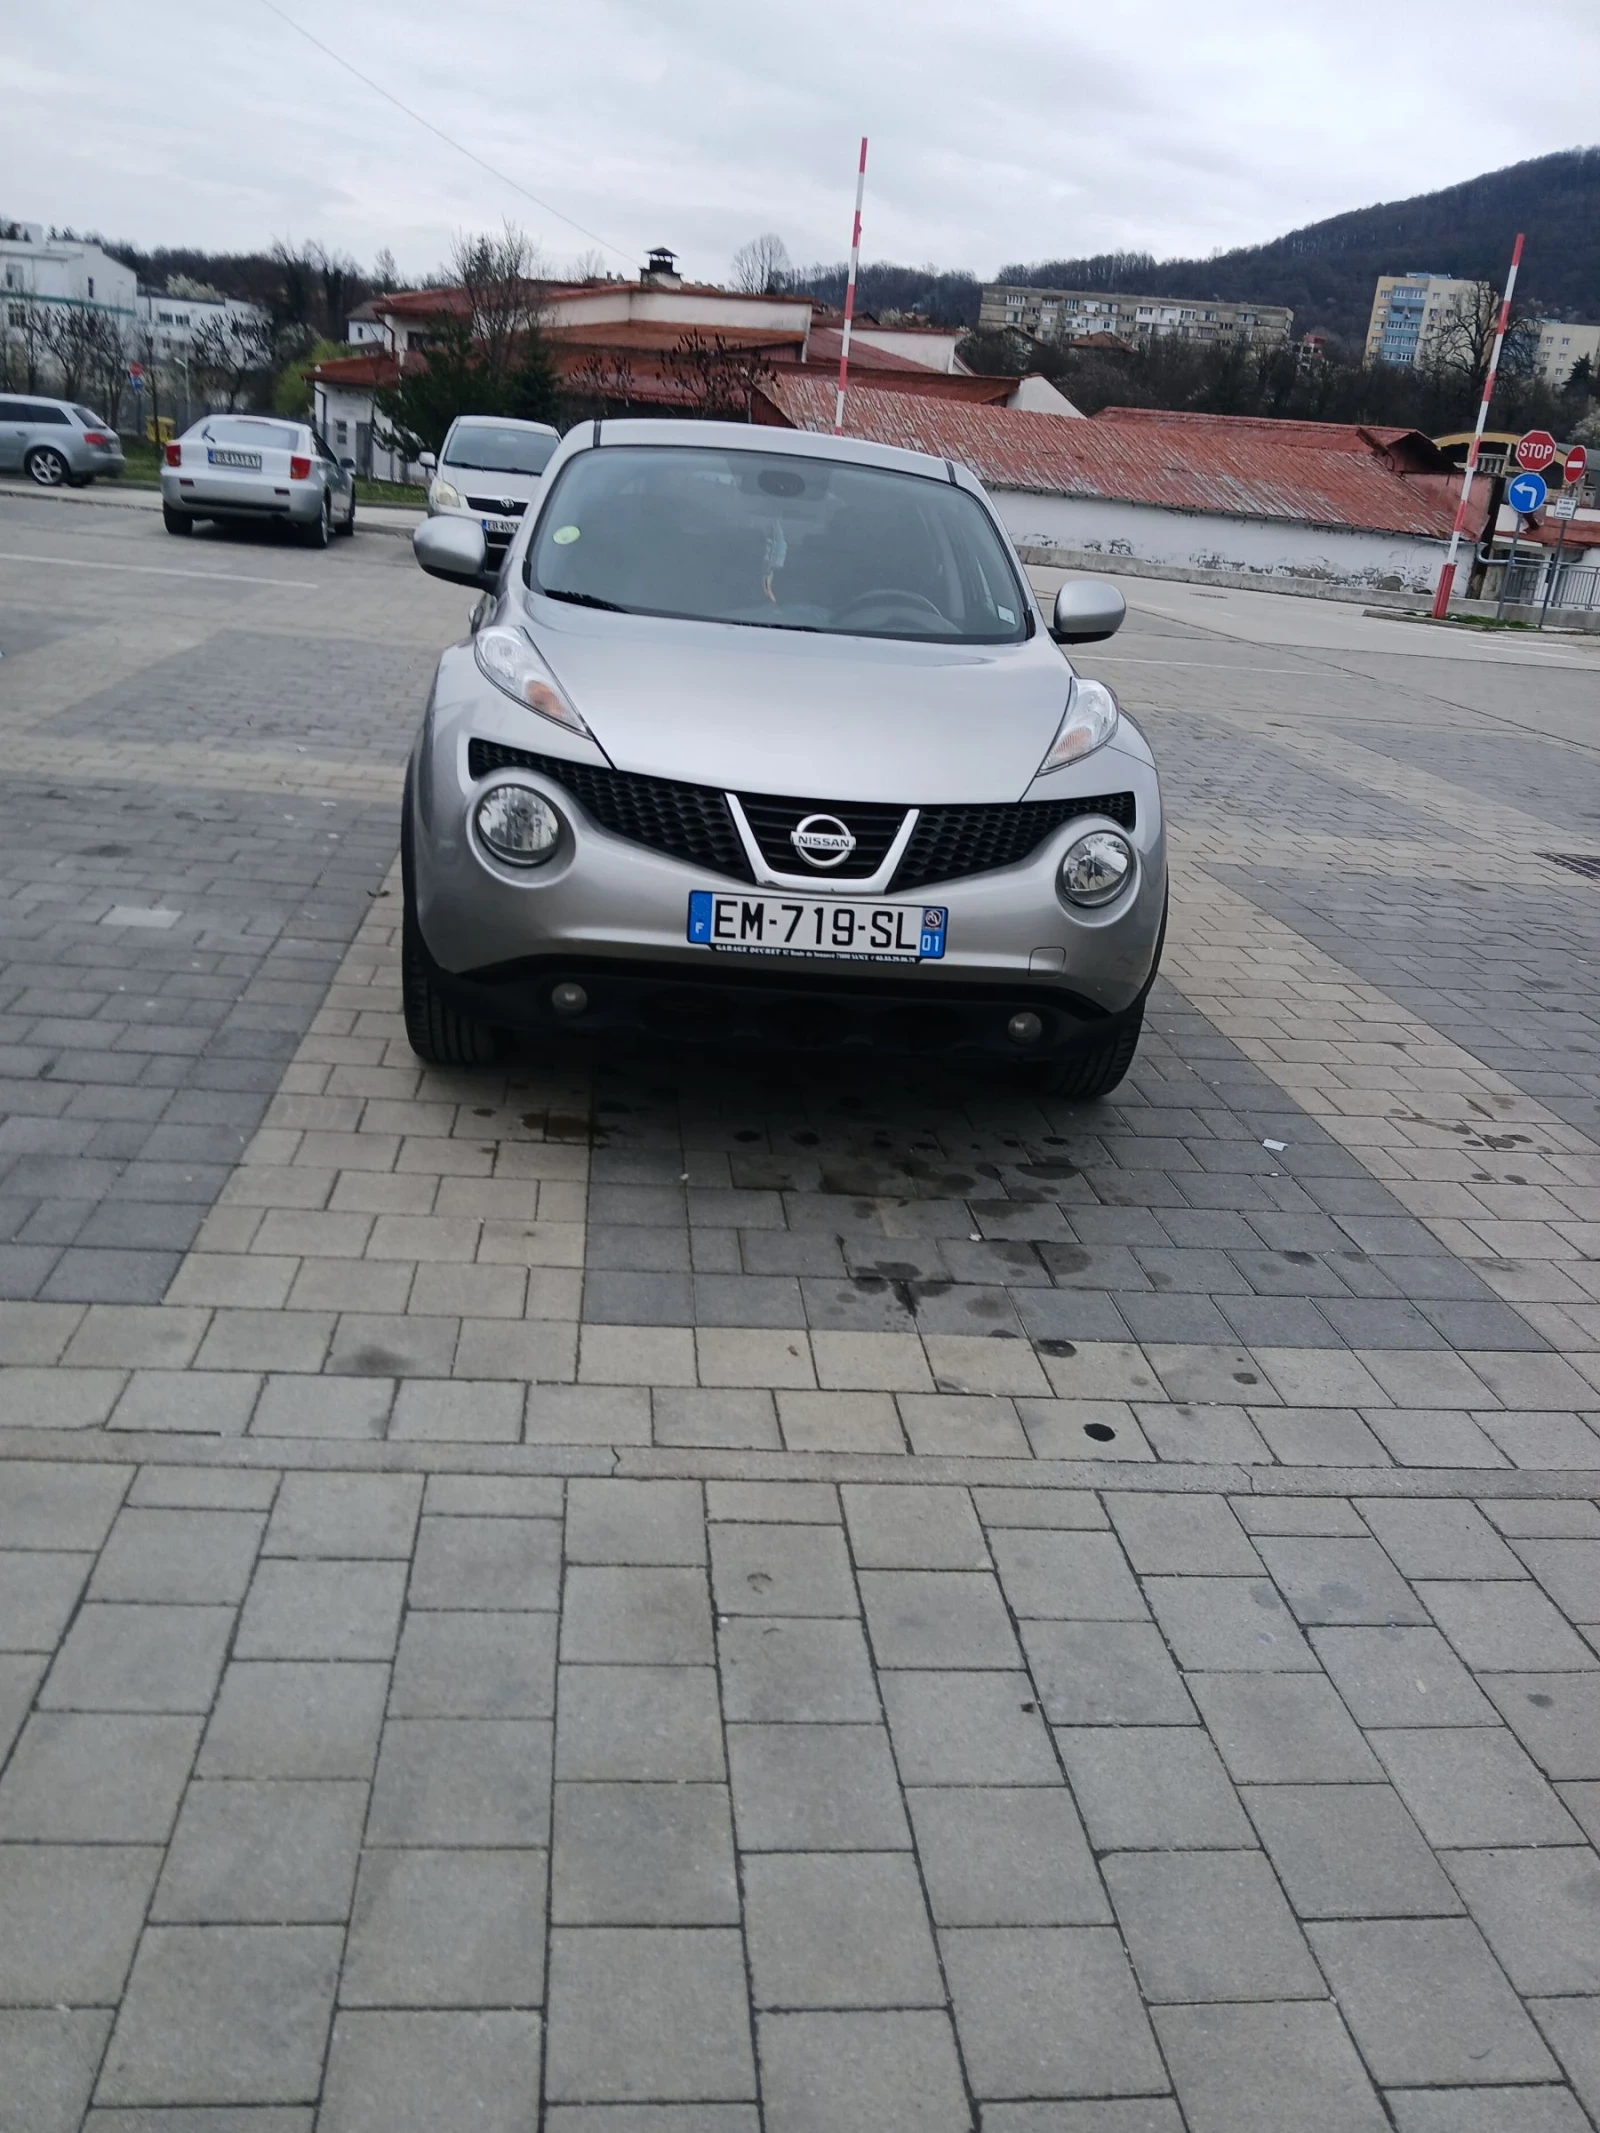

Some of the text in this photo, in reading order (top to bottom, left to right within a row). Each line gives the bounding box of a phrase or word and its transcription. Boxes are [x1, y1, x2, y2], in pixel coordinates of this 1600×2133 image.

[1519, 442, 1553, 460] STOP
[798, 835, 850, 848] NISSAN
[695, 921, 705, 935] F
[714, 899, 917, 950] EM-719-SL
[921, 934, 940, 953] 01
